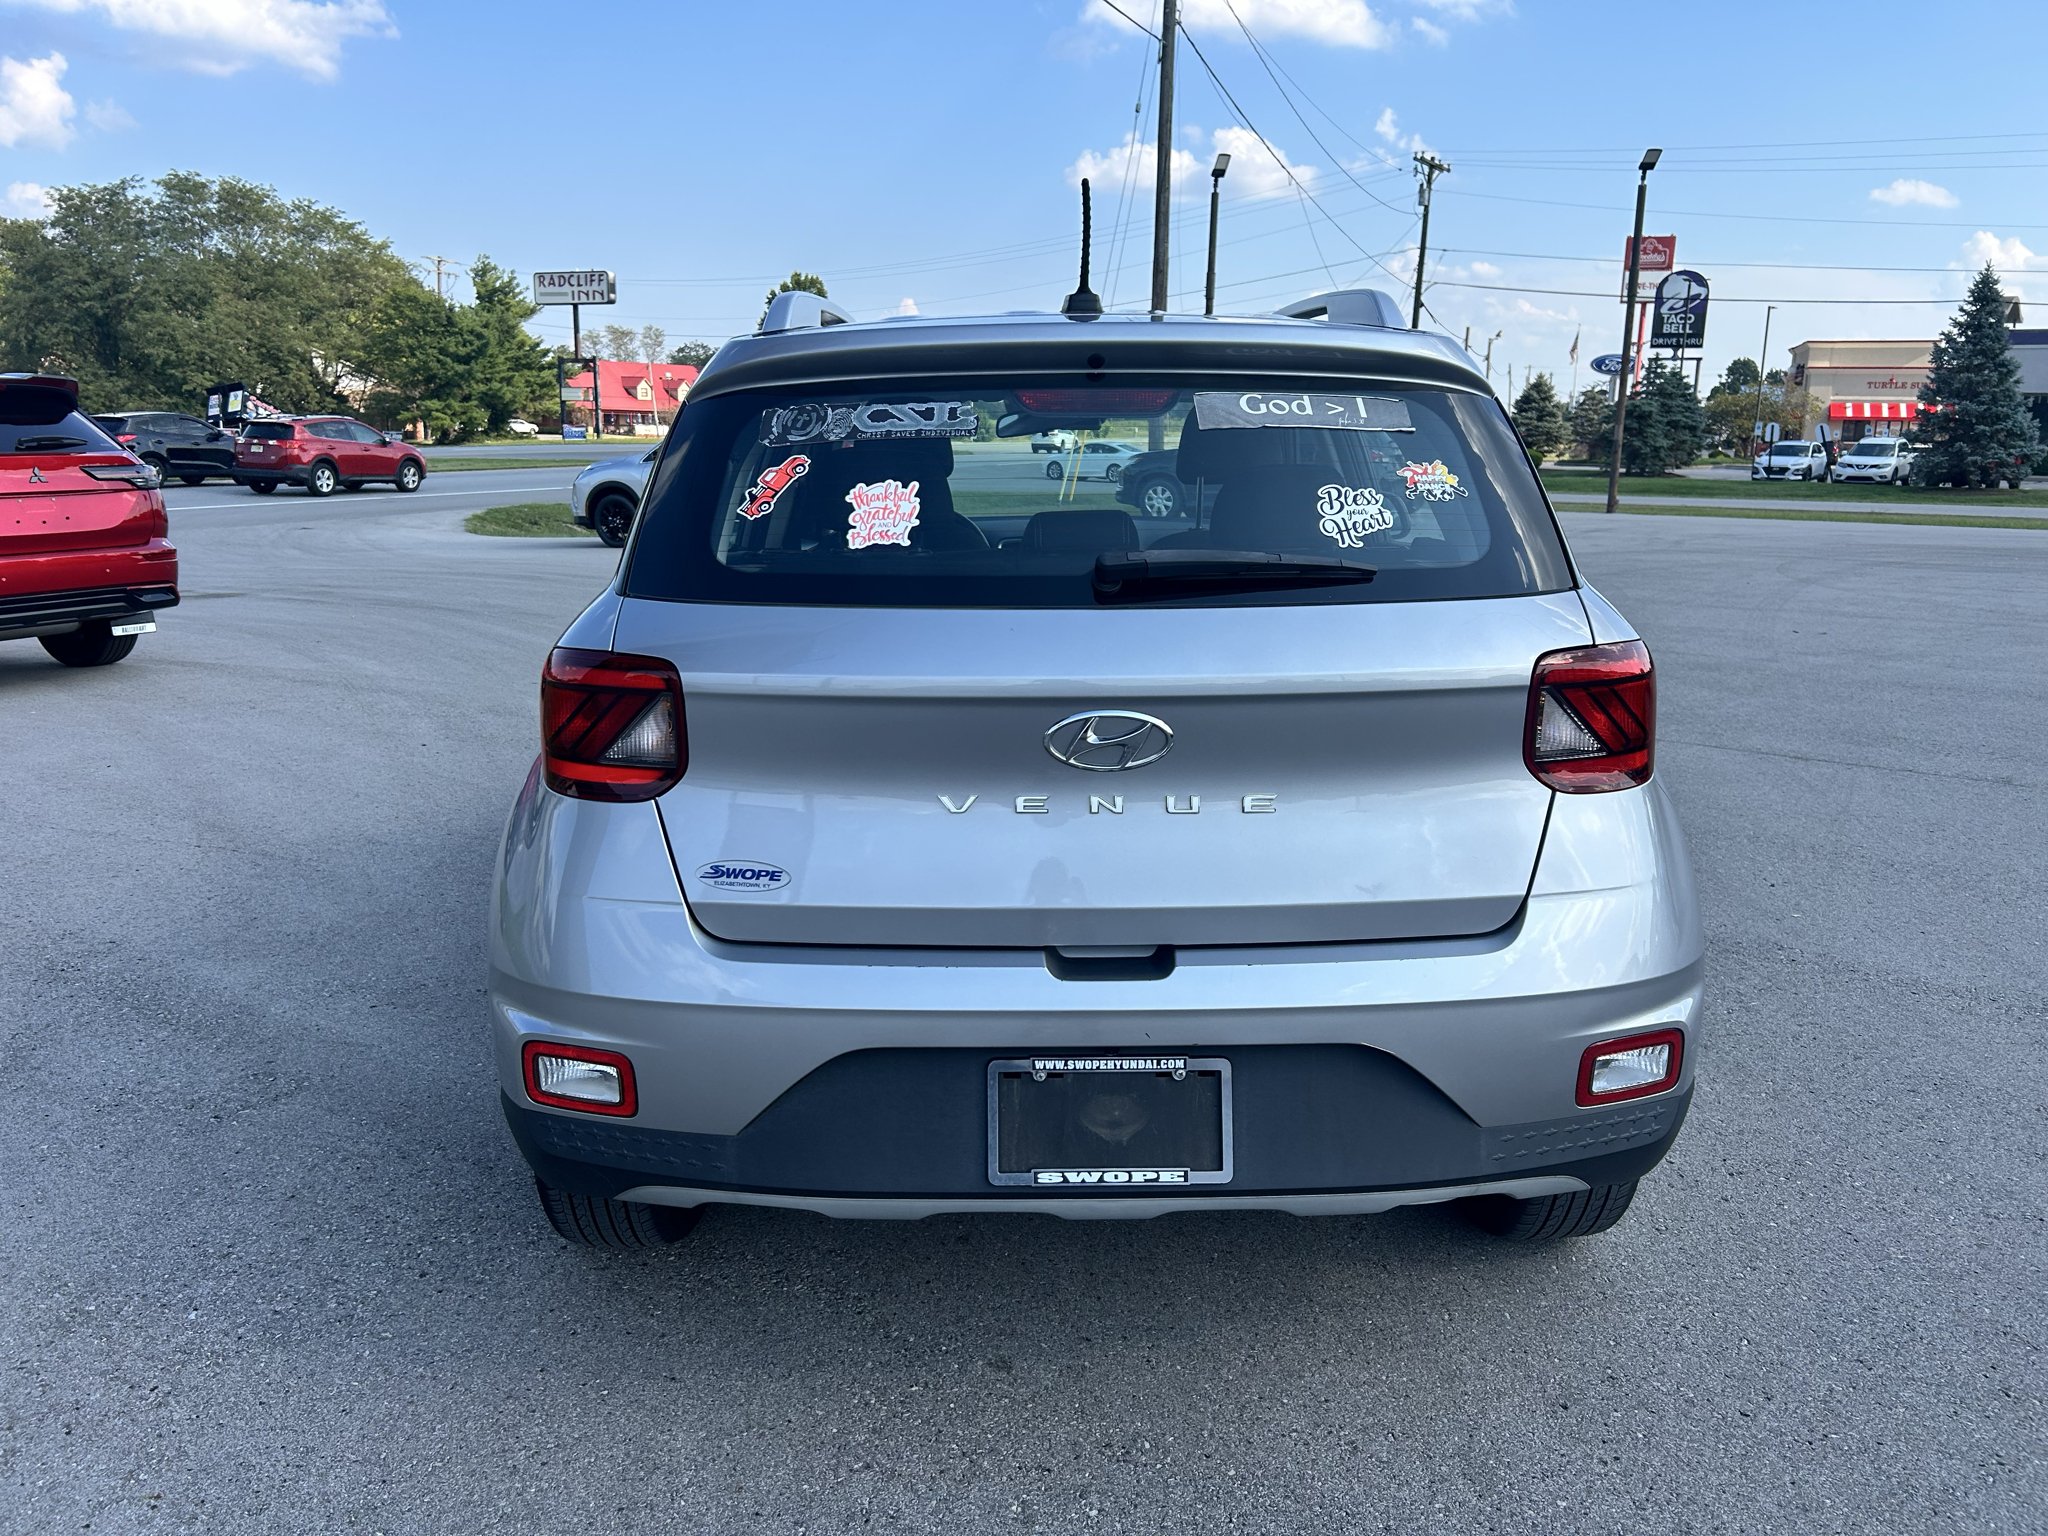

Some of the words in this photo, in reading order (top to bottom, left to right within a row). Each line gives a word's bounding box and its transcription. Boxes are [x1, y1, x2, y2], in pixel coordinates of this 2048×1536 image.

[537, 273, 605, 288] RADCLIFF
[571, 289, 605, 301] INN
[1662, 313, 1696, 324] TACO
[1662, 323, 1693, 334] BELL
[1652, 337, 1678, 346] DRIVE
[1679, 337, 1703, 346] THRU
[1866, 381, 1908, 390] TURTLE
[1239, 394, 1314, 416] God
[857, 431, 887, 439] CHRIST
[891, 430, 916, 438] SAVES
[921, 429, 976, 437] INDIVIDUALS
[1413, 474, 1447, 482] HAPPY
[1416, 482, 1451, 491] DANCE
[1320, 486, 1382, 516] Bless
[851, 503, 917, 532] grateful
[1346, 508, 1369, 519] your
[1322, 507, 1391, 546] Heart
[850, 522, 909, 547] Blessed
[937, 794, 1279, 814] VENUE
[699, 864, 784, 882] SWOPE
[1034, 1059, 1185, 1070] WWW.SWOPEHYUNDAI.COM
[1036, 1171, 1185, 1184] SWOPE
